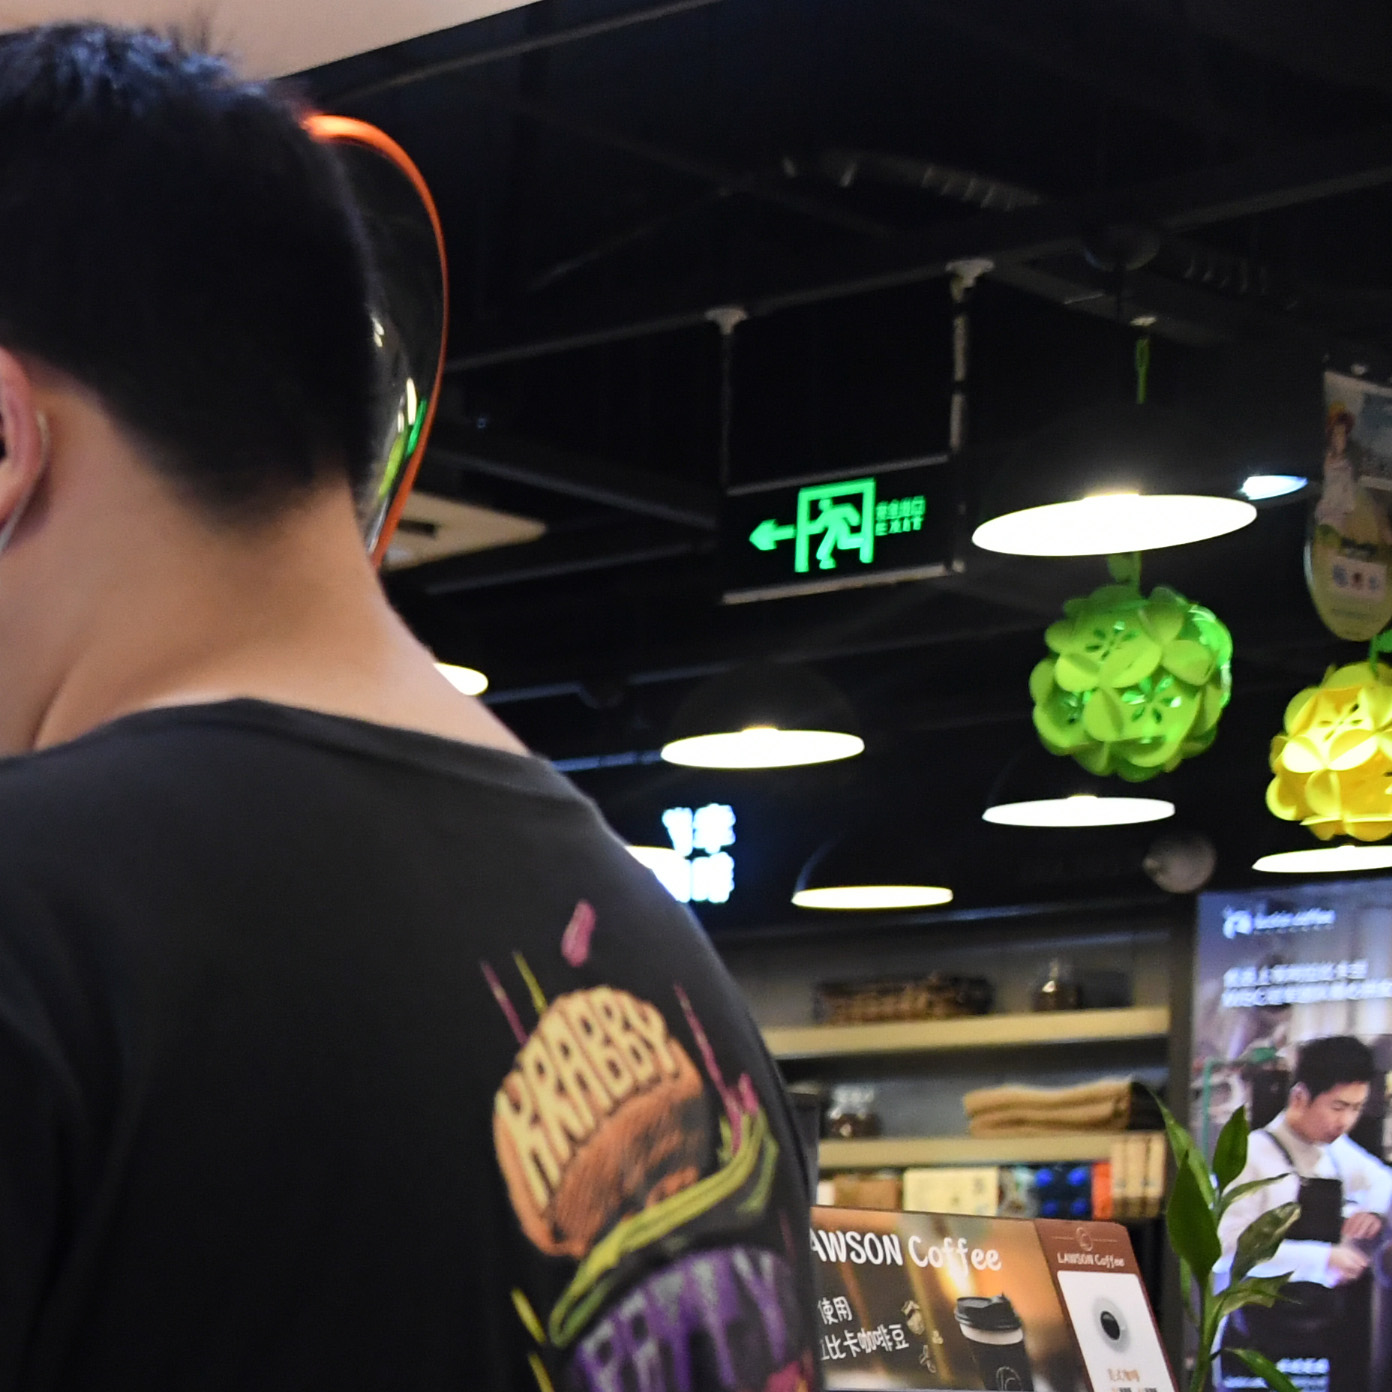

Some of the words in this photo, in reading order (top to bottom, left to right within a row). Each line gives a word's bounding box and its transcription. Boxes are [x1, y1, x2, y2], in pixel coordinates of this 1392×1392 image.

[875, 517, 924, 537] EXIT
[494, 983, 680, 1211] KRABBY
[907, 1235, 1003, 1277] Coffee
[1056, 1252, 1095, 1266] LAWSON
[1094, 1254, 1126, 1269] Coffee
[817, 1295, 853, 1325] 使用
